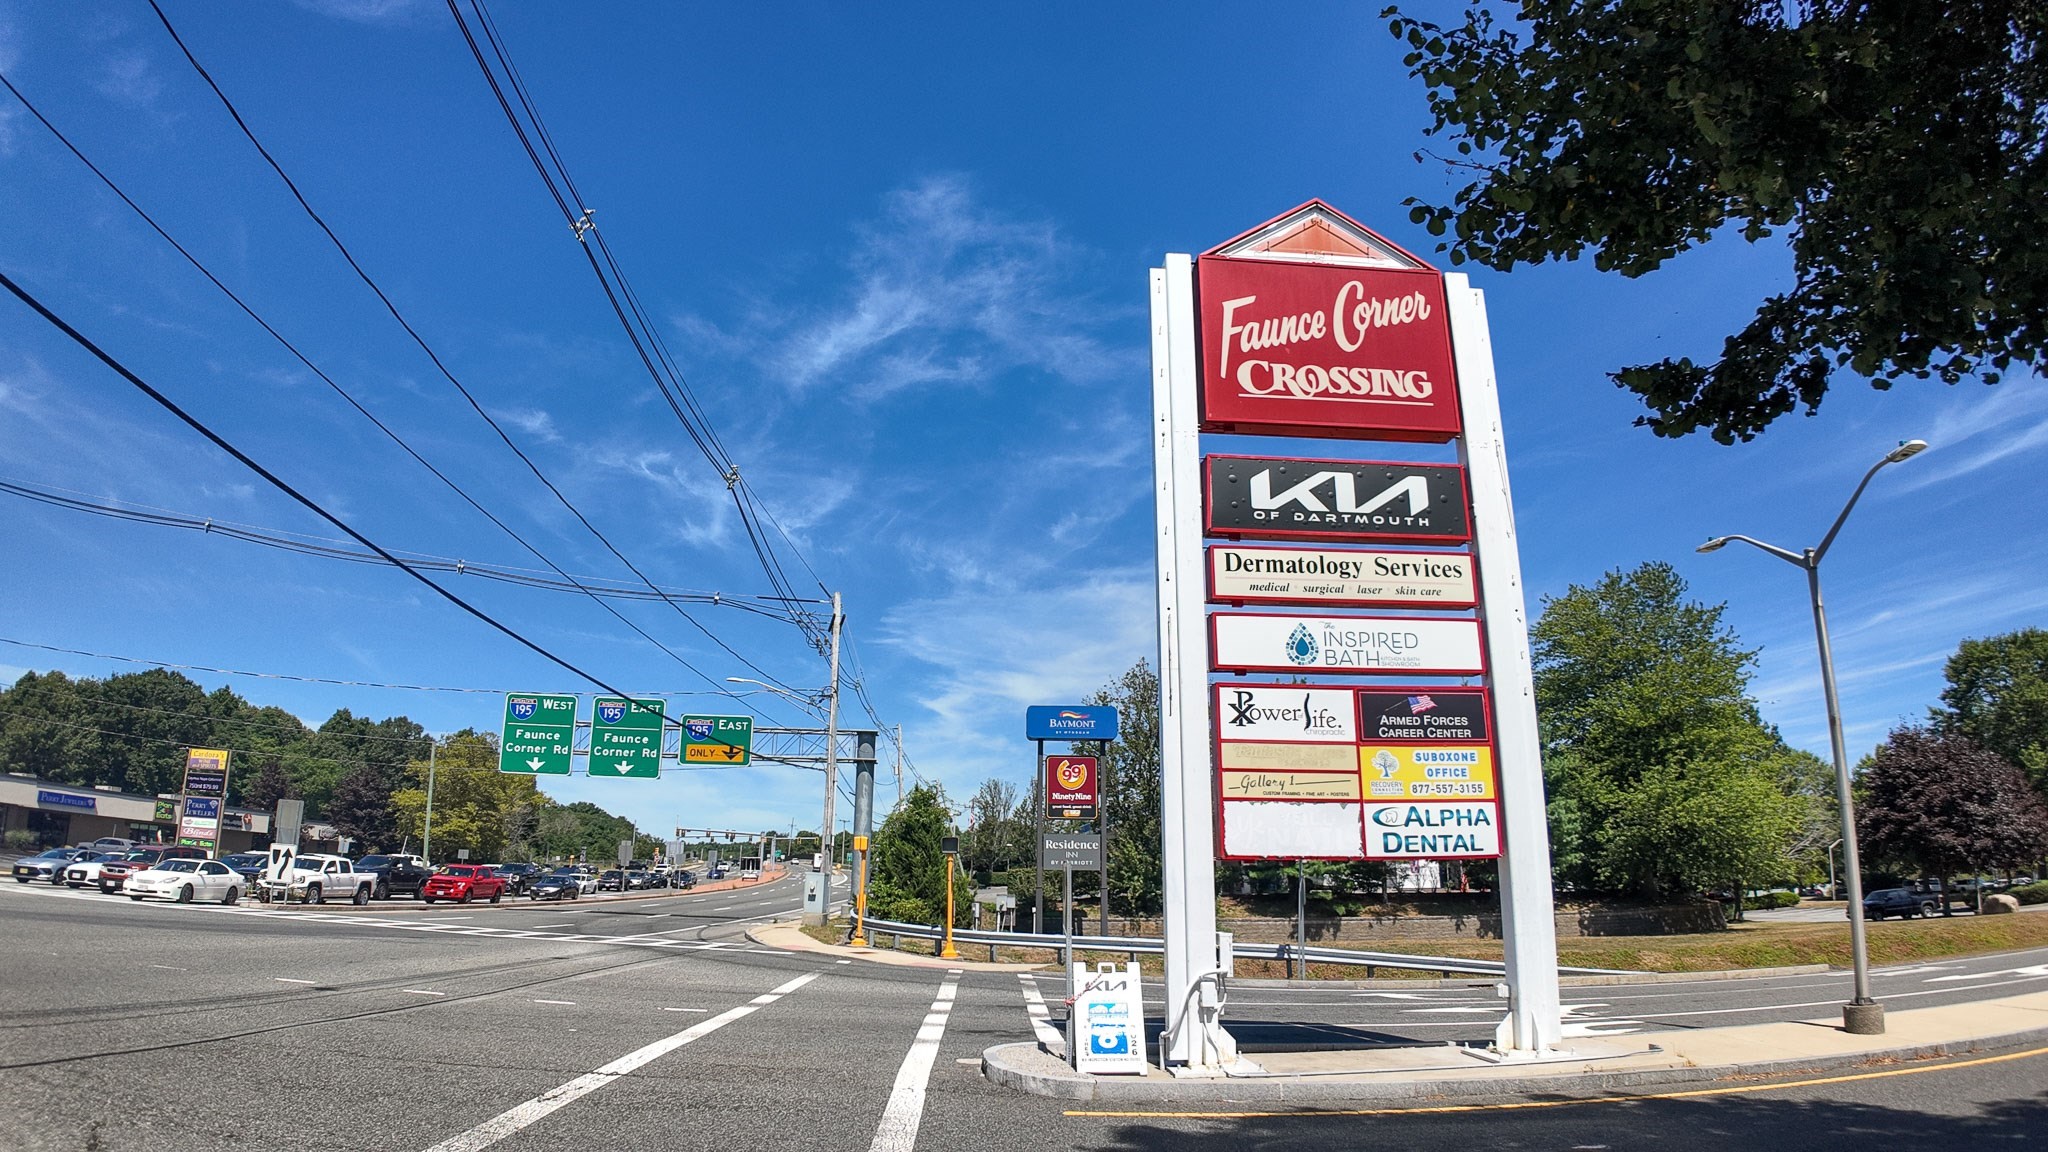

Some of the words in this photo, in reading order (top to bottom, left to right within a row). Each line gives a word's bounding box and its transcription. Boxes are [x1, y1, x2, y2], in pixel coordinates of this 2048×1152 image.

[1220, 295, 1326, 379] Faunce
[1333, 280, 1431, 352] Corner
[1237, 360, 1433, 399] CROSSING
[1250, 468, 1429, 516] KIA
[1253, 511, 1280, 520] OF
[1293, 512, 1430, 527] DARTMOUTH
[1225, 552, 1363, 579] Dermatology
[1374, 556, 1463, 579] Services
[1249, 582, 1290, 592] medical
[1303, 584, 1345, 595] surgical
[1357, 585, 1383, 595] laser
[1395, 586, 1416, 595] skin
[1420, 588, 1442, 596] care
[1323, 631, 1419, 655] INSPIRED
[1325, 649, 1380, 666] BATH
[515, 704, 533, 716] 195
[543, 699, 574, 710] WEST
[603, 708, 621, 719] 195
[631, 702, 661, 714] EAST
[1049, 718, 1097, 728] BAYMONT
[1380, 715, 1421, 726] ARMED
[1423, 715, 1469, 726] FORCES
[516, 728, 561, 740] Faunce
[691, 725, 709, 737] 195
[718, 719, 749, 731] EAST
[1305, 728, 1346, 736] chiropractic
[1378, 727, 1425, 738] CAREER
[1426, 727, 1472, 738] CENTER
[603, 732, 649, 745] Faunce
[505, 742, 547, 754] Corner
[553, 744, 569, 755] Rd
[593, 746, 636, 757] Corner
[642, 748, 658, 758] Rd
[689, 748, 716, 758] ONLY
[1415, 752, 1476, 762] SUBOXONE
[1062, 764, 1082, 781] 99
[1426, 768, 1467, 777] OFFICE
[1411, 783, 1484, 794] 877-557-3155
[187, 799, 206, 809] PERRY
[185, 808, 215, 816] JEWELERS
[1404, 806, 1491, 827] ALPHA
[1045, 839, 1099, 849] Residence
[1382, 832, 1484, 853] DENTAL
